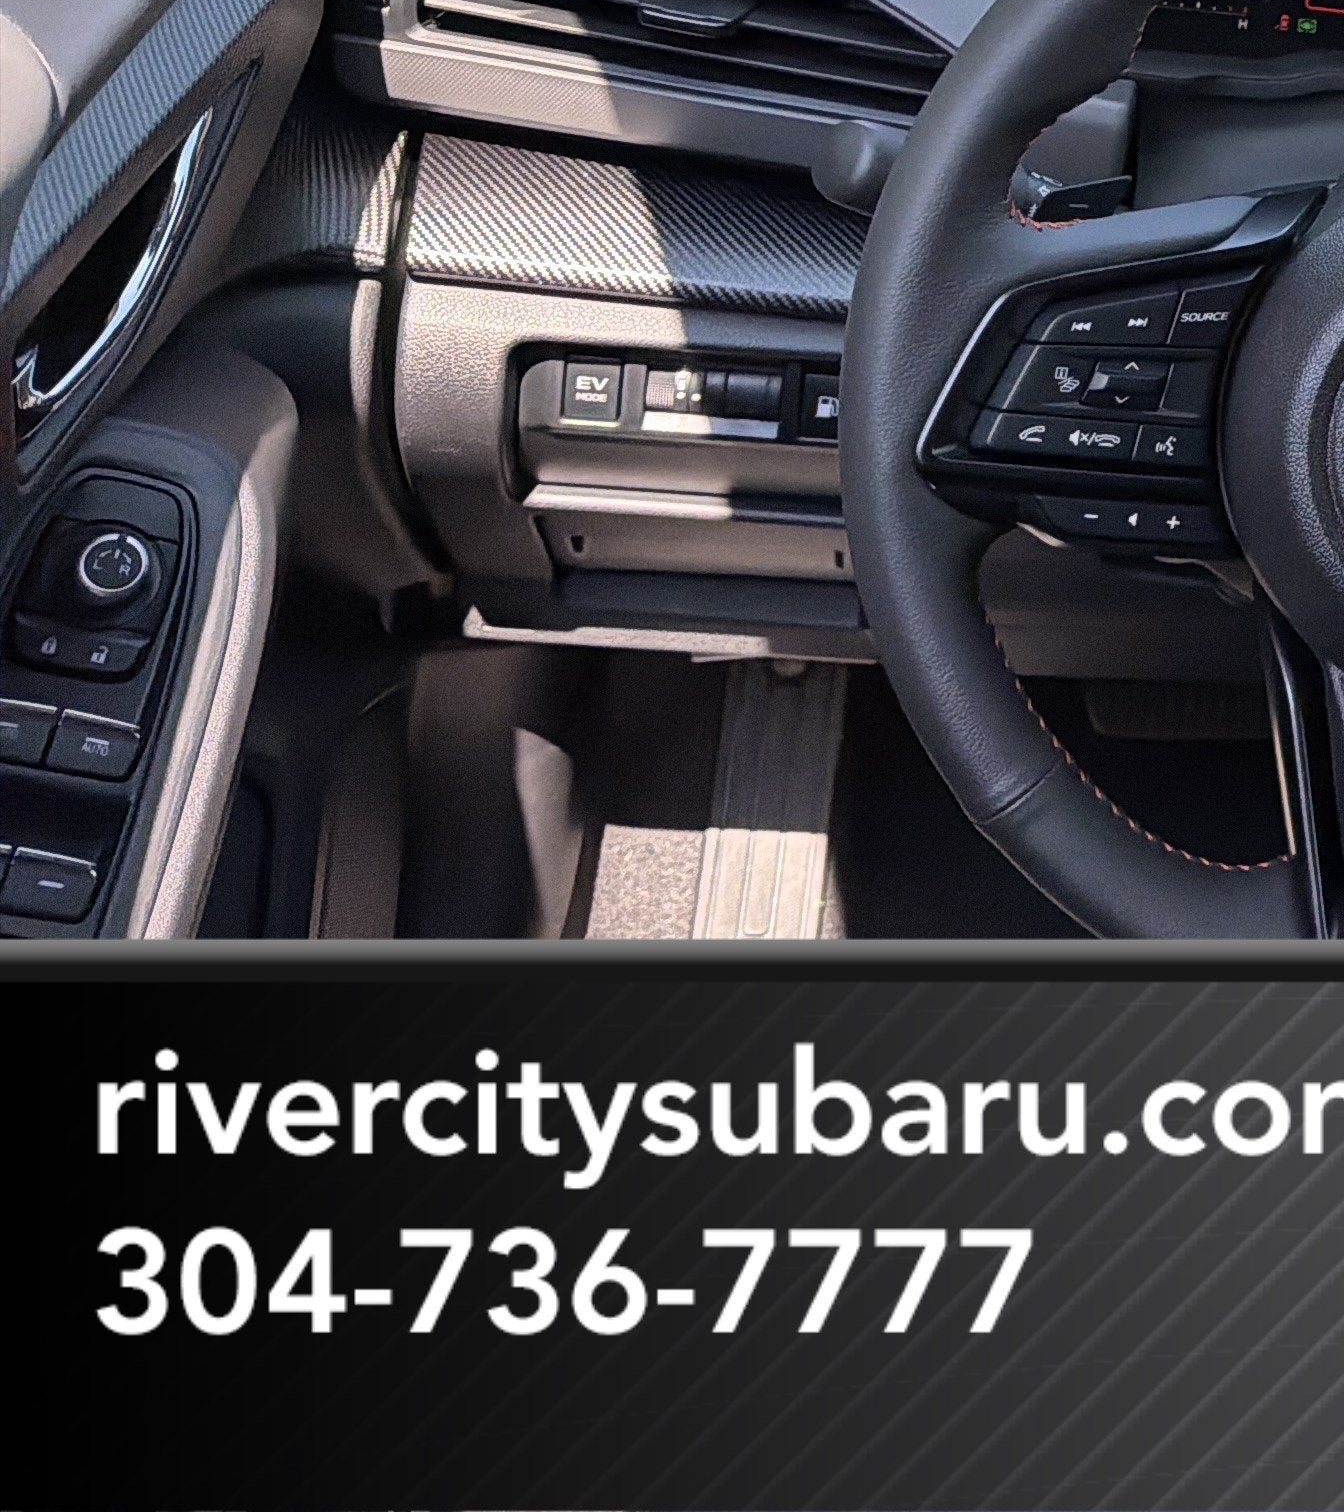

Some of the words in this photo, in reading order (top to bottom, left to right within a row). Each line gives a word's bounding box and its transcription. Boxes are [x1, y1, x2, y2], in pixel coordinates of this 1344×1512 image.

[1237, 19, 1249, 30] H
[1180, 310, 1230, 323] SOURCE
[575, 375, 610, 391] EV
[81, 741, 109, 757] AUTO
